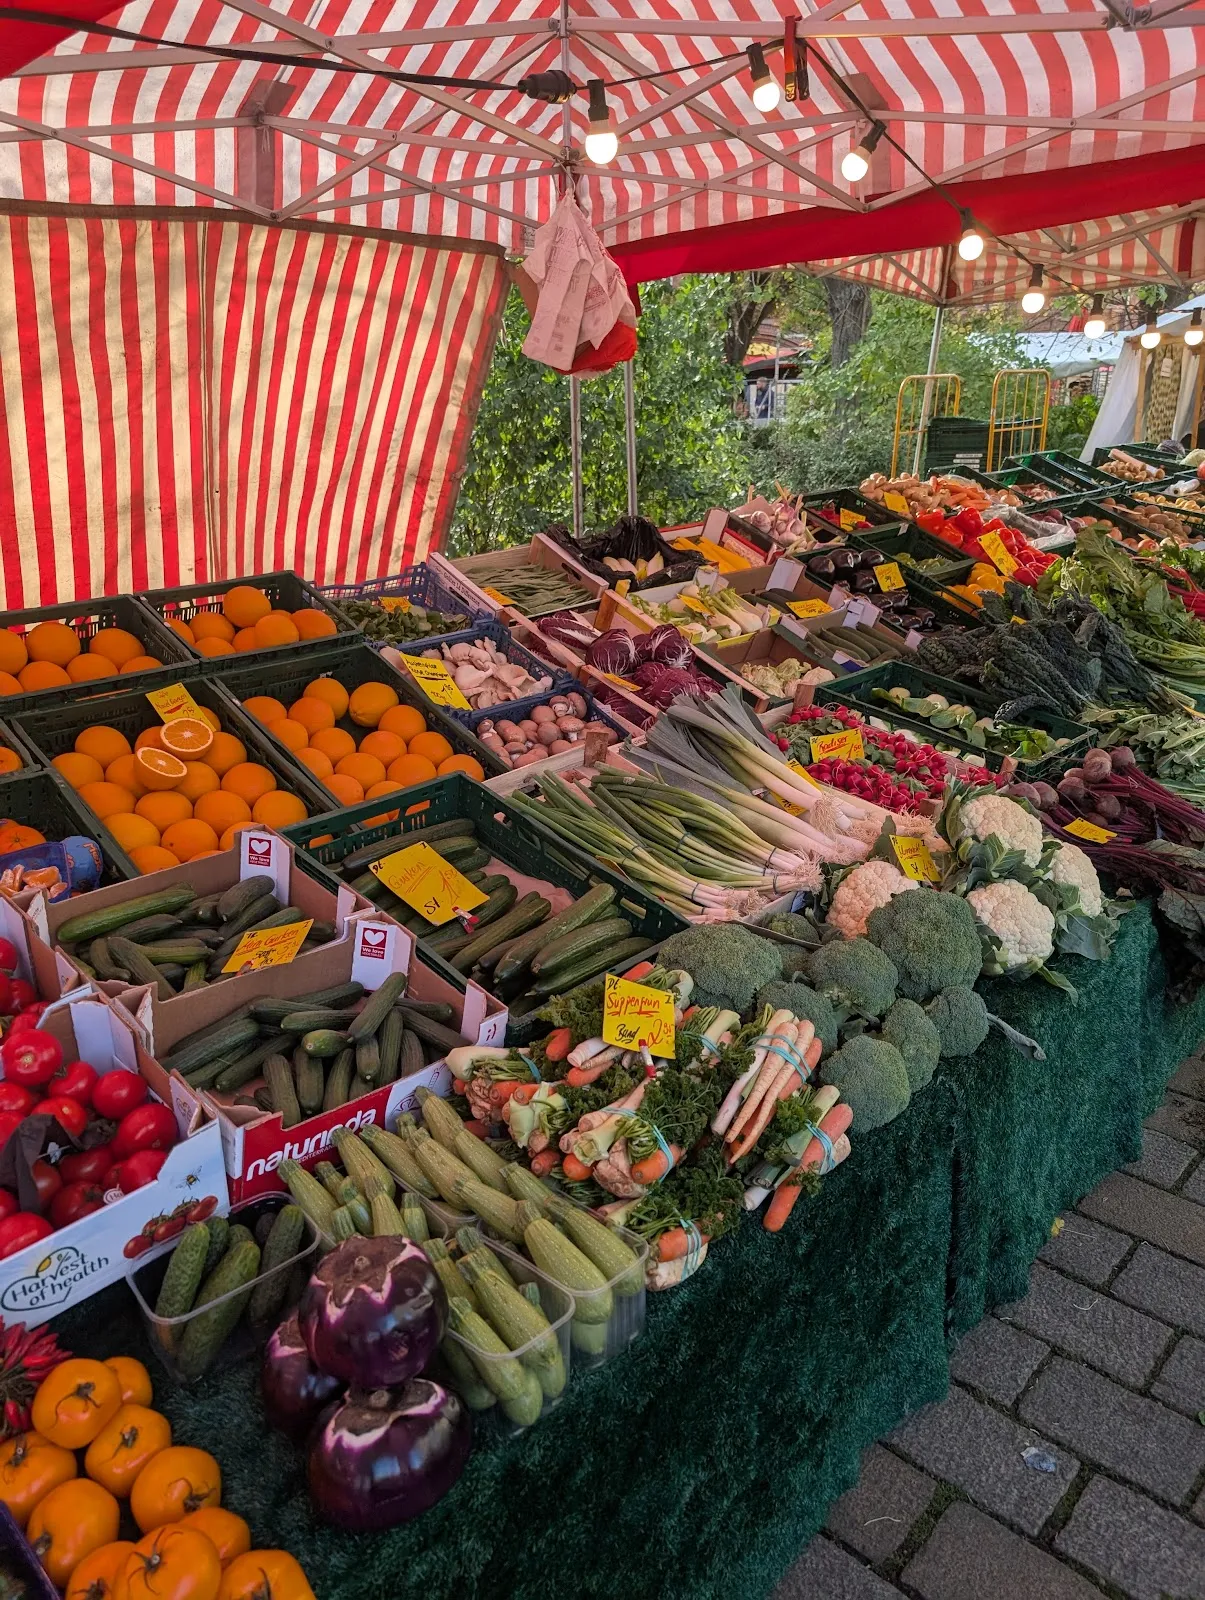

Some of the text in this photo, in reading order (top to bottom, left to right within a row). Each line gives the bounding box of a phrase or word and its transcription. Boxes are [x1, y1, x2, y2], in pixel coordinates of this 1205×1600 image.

[11, 1252, 89, 1303] Harvest
[29, 1256, 110, 1306] of health
